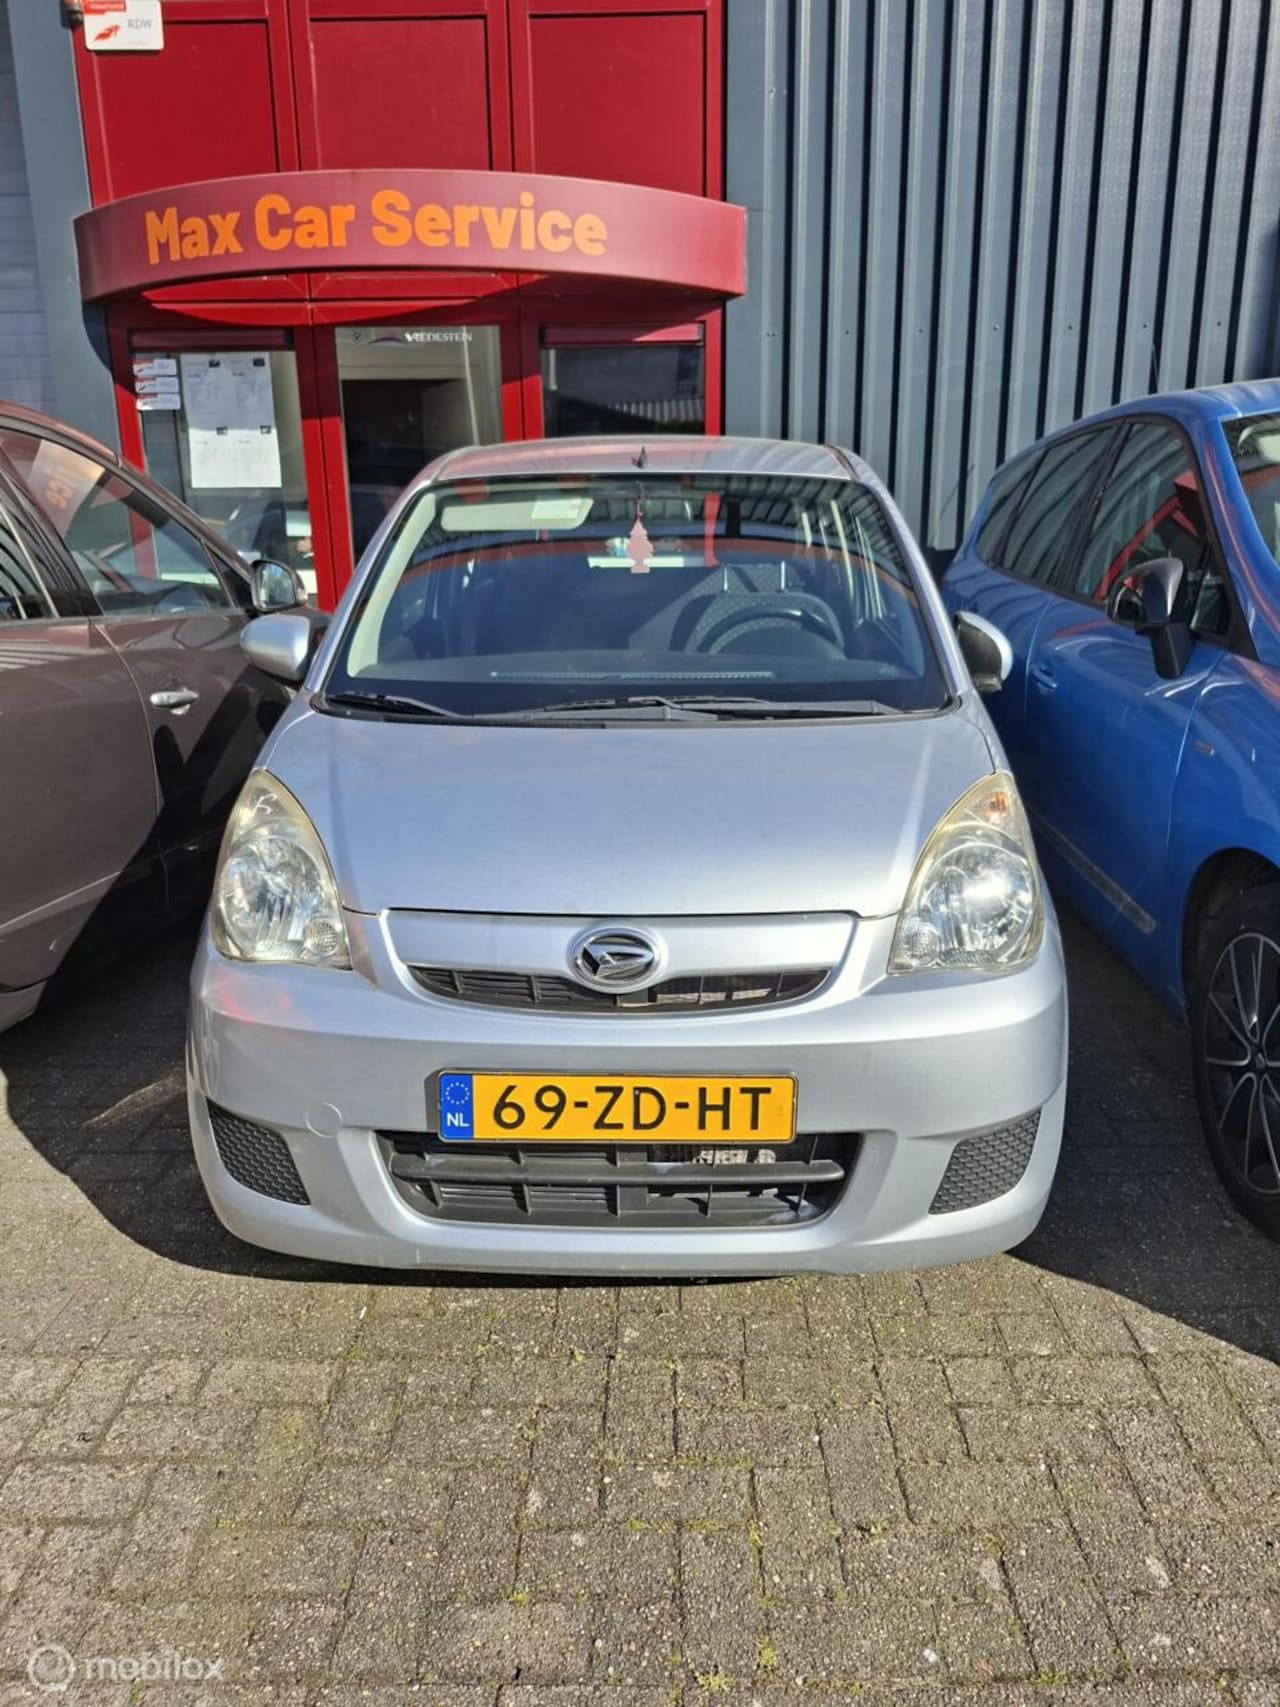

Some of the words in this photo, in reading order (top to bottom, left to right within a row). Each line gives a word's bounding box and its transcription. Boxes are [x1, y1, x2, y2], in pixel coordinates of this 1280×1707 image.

[127, 19, 152, 30] RDW
[144, 206, 244, 265] Max
[253, 193, 356, 252] Car
[370, 189, 608, 257] Service
[446, 1112, 470, 1128] NL
[492, 1084, 773, 1131] 69-ZD-HT
